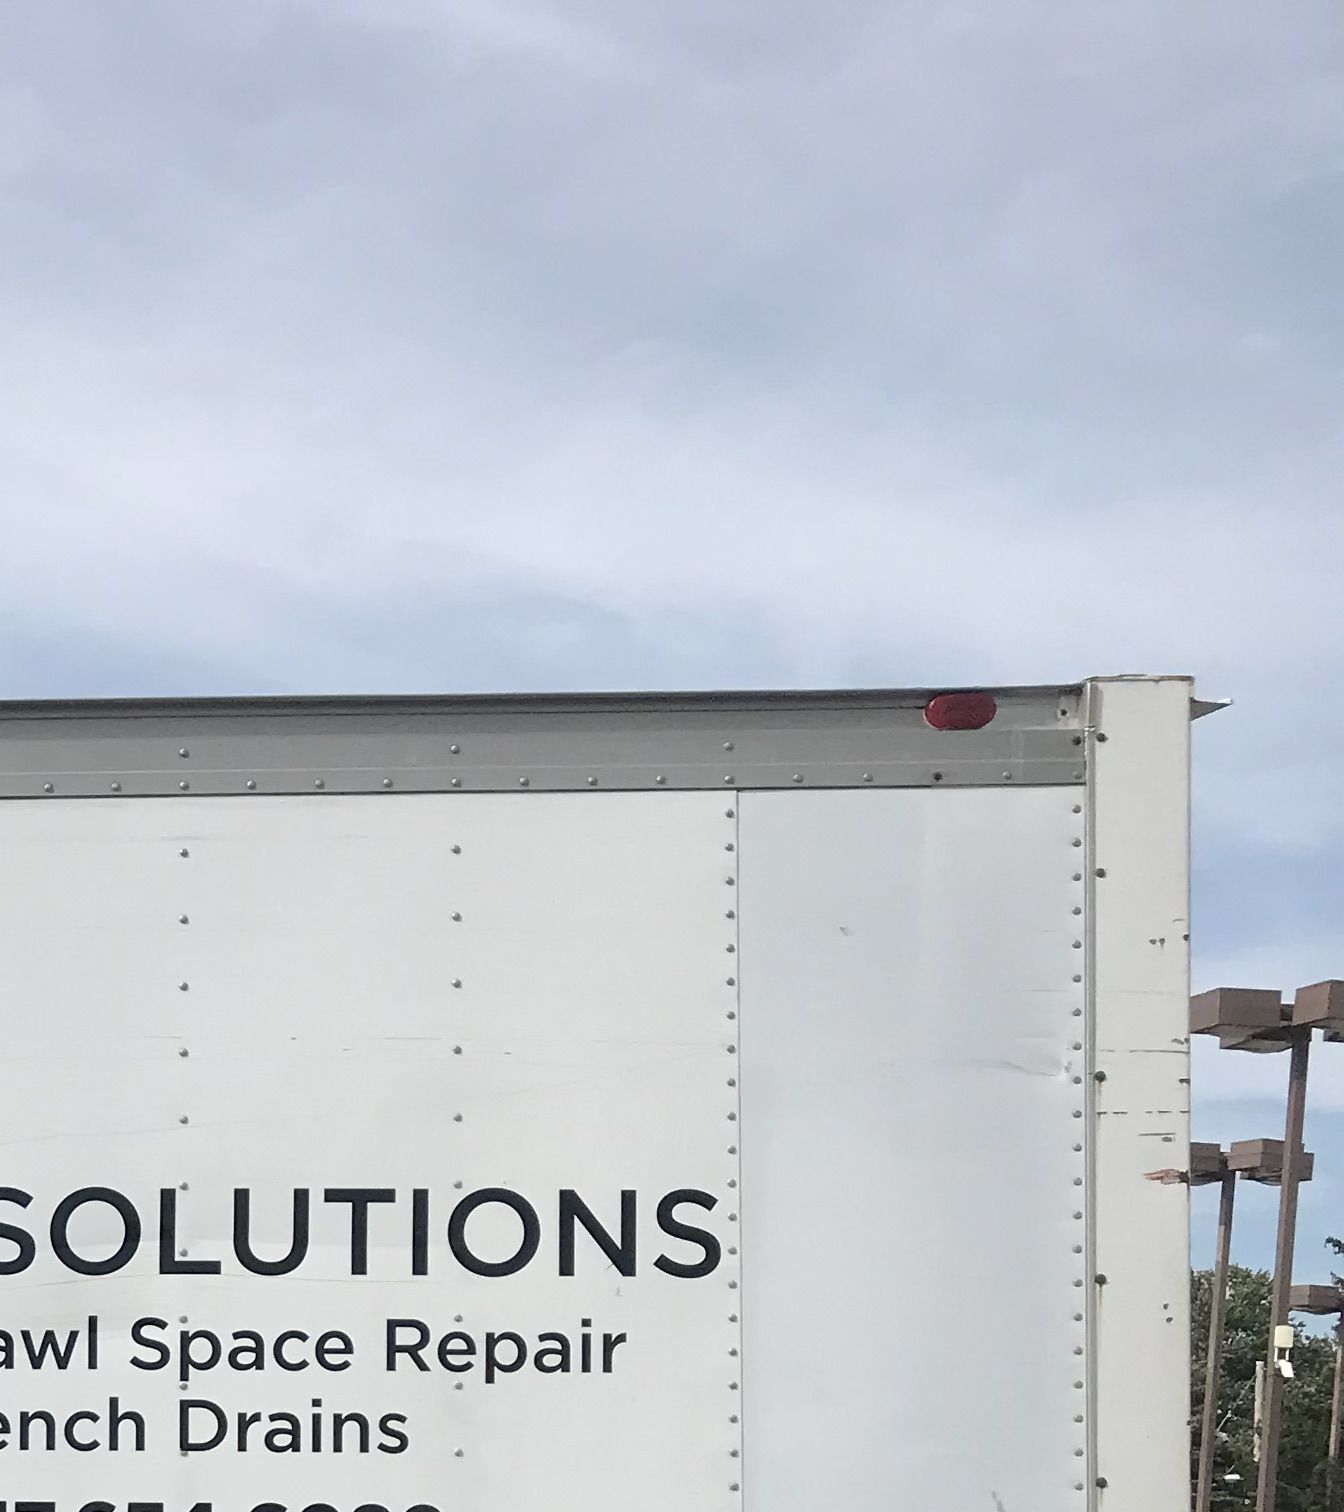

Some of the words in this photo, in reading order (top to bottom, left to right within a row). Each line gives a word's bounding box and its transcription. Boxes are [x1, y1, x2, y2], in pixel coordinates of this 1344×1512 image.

[129, 1317, 354, 1382] Space
[386, 1318, 627, 1384] Repair
[179, 1398, 409, 1454] Drains
